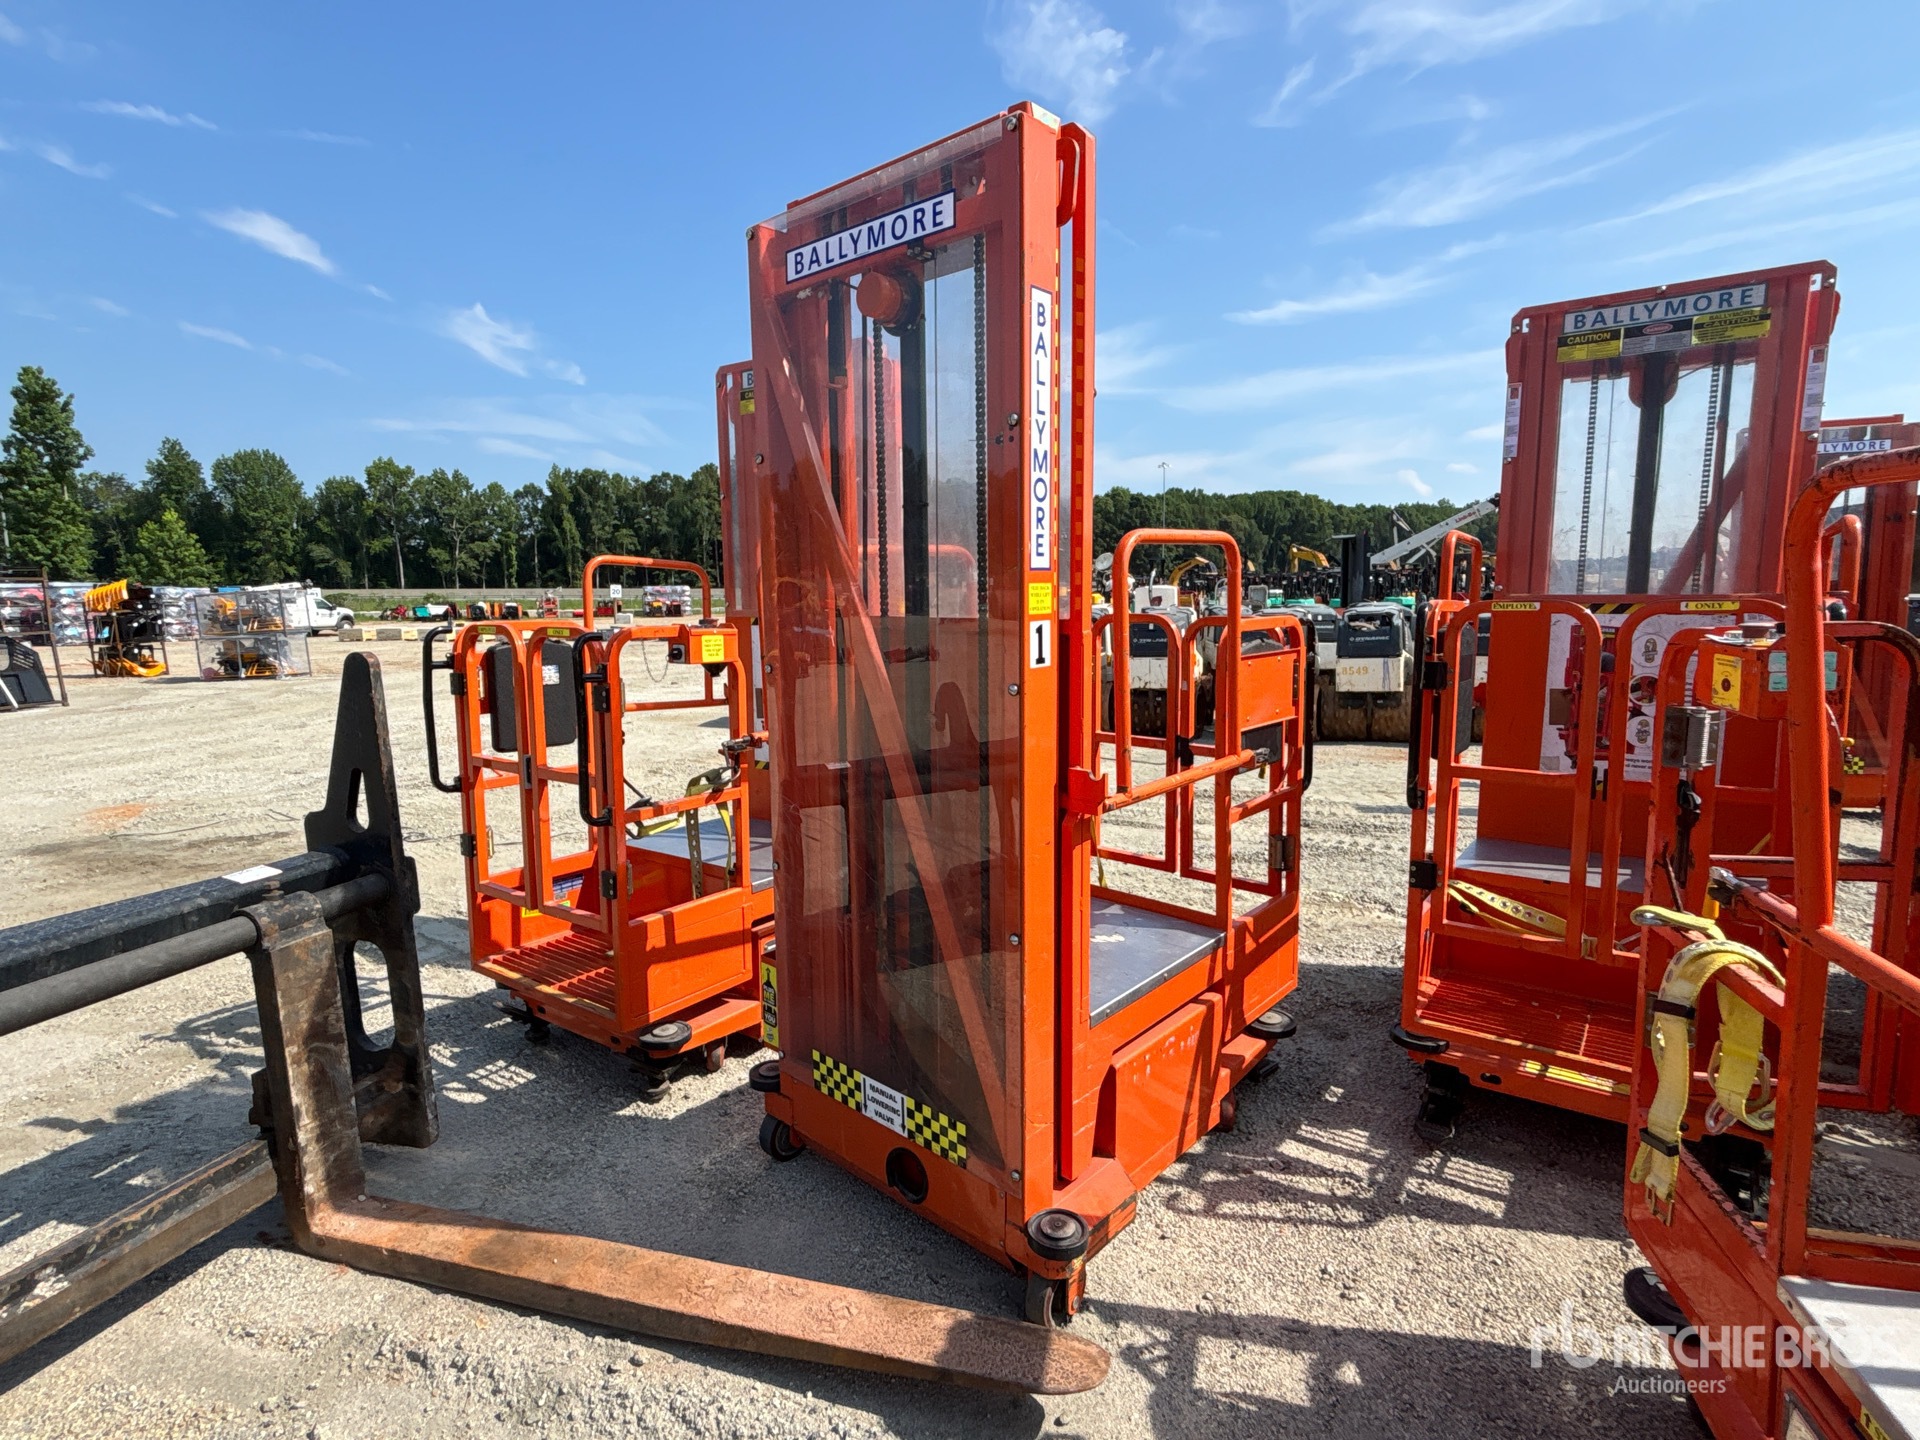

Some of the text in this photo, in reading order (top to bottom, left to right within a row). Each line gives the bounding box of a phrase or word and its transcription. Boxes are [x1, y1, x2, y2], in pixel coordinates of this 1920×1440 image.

[794, 199, 944, 276] BALLYMORE
[1573, 287, 1754, 330] BALLYMORE
[1703, 316, 1760, 328] CAUTION
[1566, 332, 1611, 345] CAUTION
[1032, 302, 1049, 558] BALLYMORE
[1817, 440, 1886, 453] LYMORE
[1035, 623, 1046, 665] 1
[869, 1082, 898, 1104] MANUAL
[867, 1094, 901, 1117] LOWERING
[873, 1108, 895, 1126] VALVE
